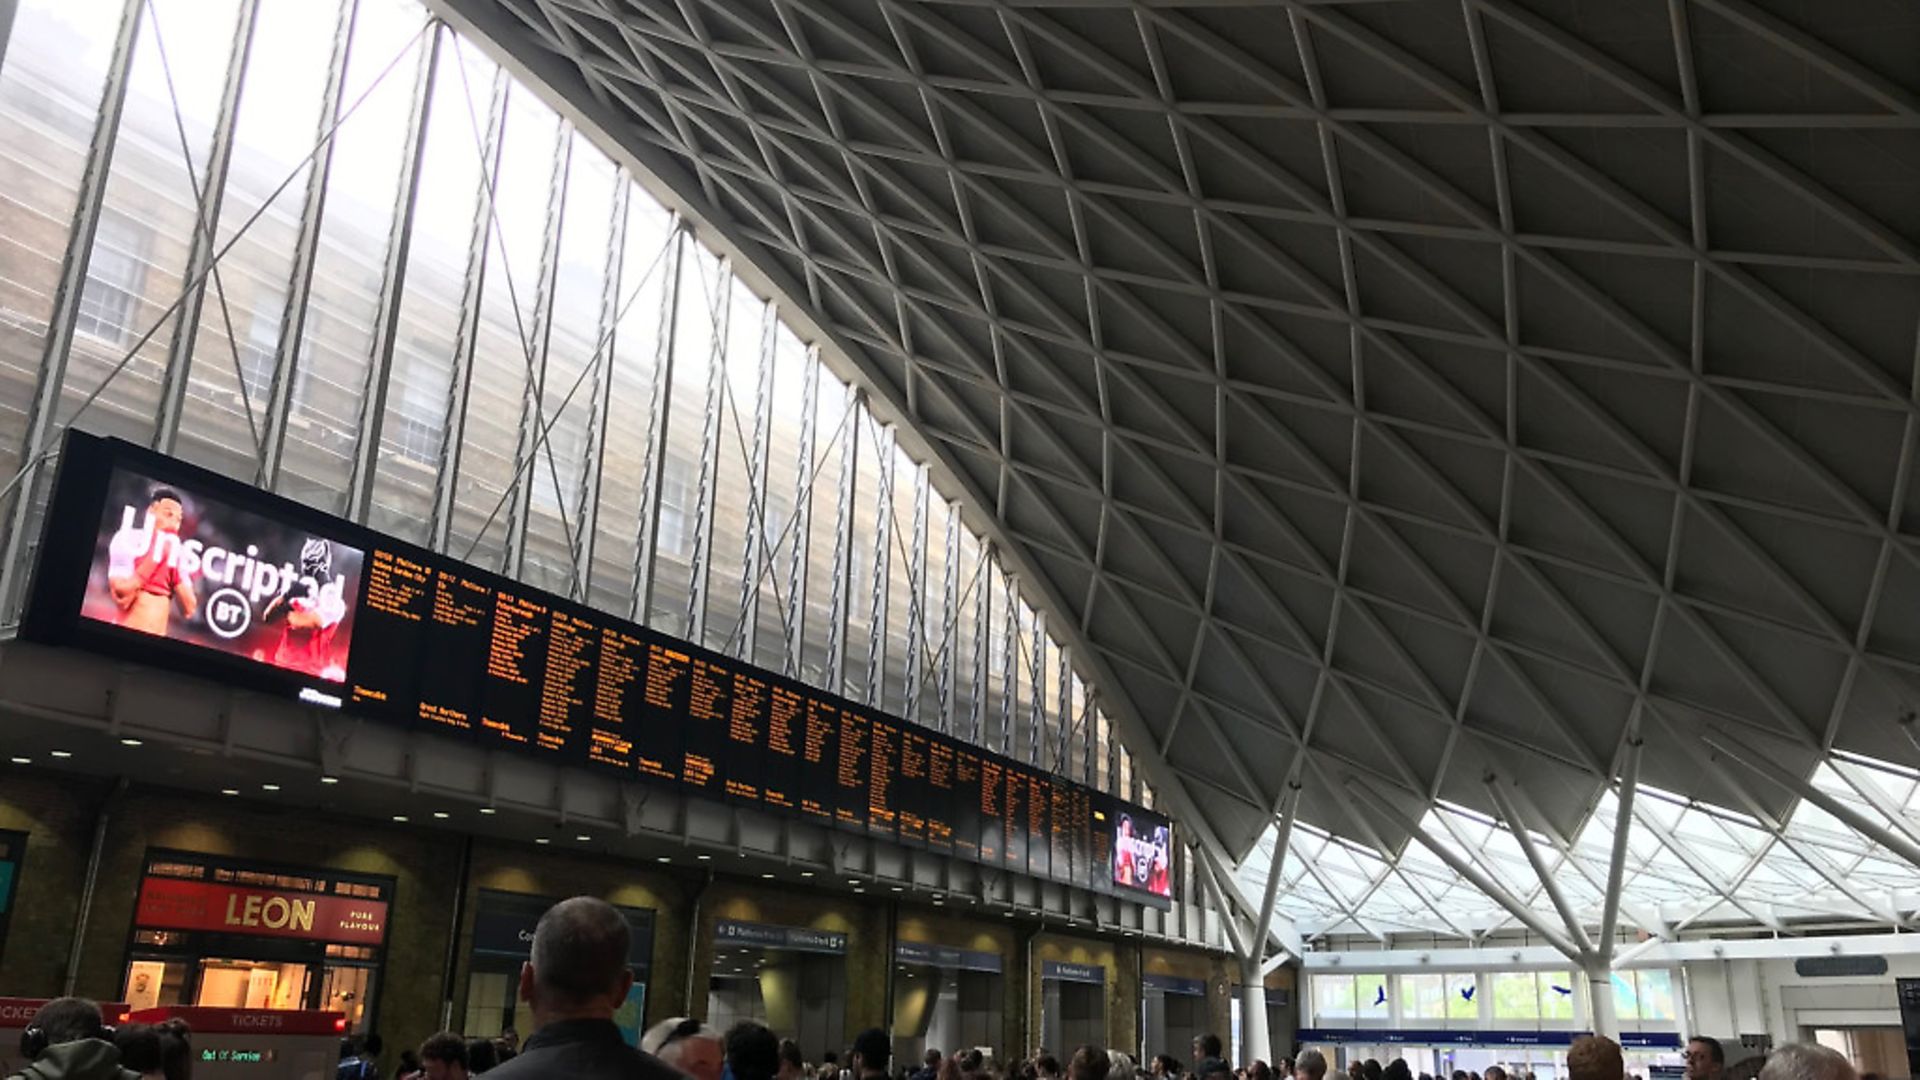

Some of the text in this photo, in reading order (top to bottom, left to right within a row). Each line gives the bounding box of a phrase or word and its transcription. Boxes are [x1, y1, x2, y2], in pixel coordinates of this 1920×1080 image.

[216, 601, 242, 626] BT
[225, 893, 316, 932] LEON
[350, 910, 373, 921] PURE
[339, 922, 380, 931] FLAVOUR
[231, 1014, 283, 1028] TICKETS
[202, 1049, 216, 1061] Out
[231, 1050, 261, 1062] Service
